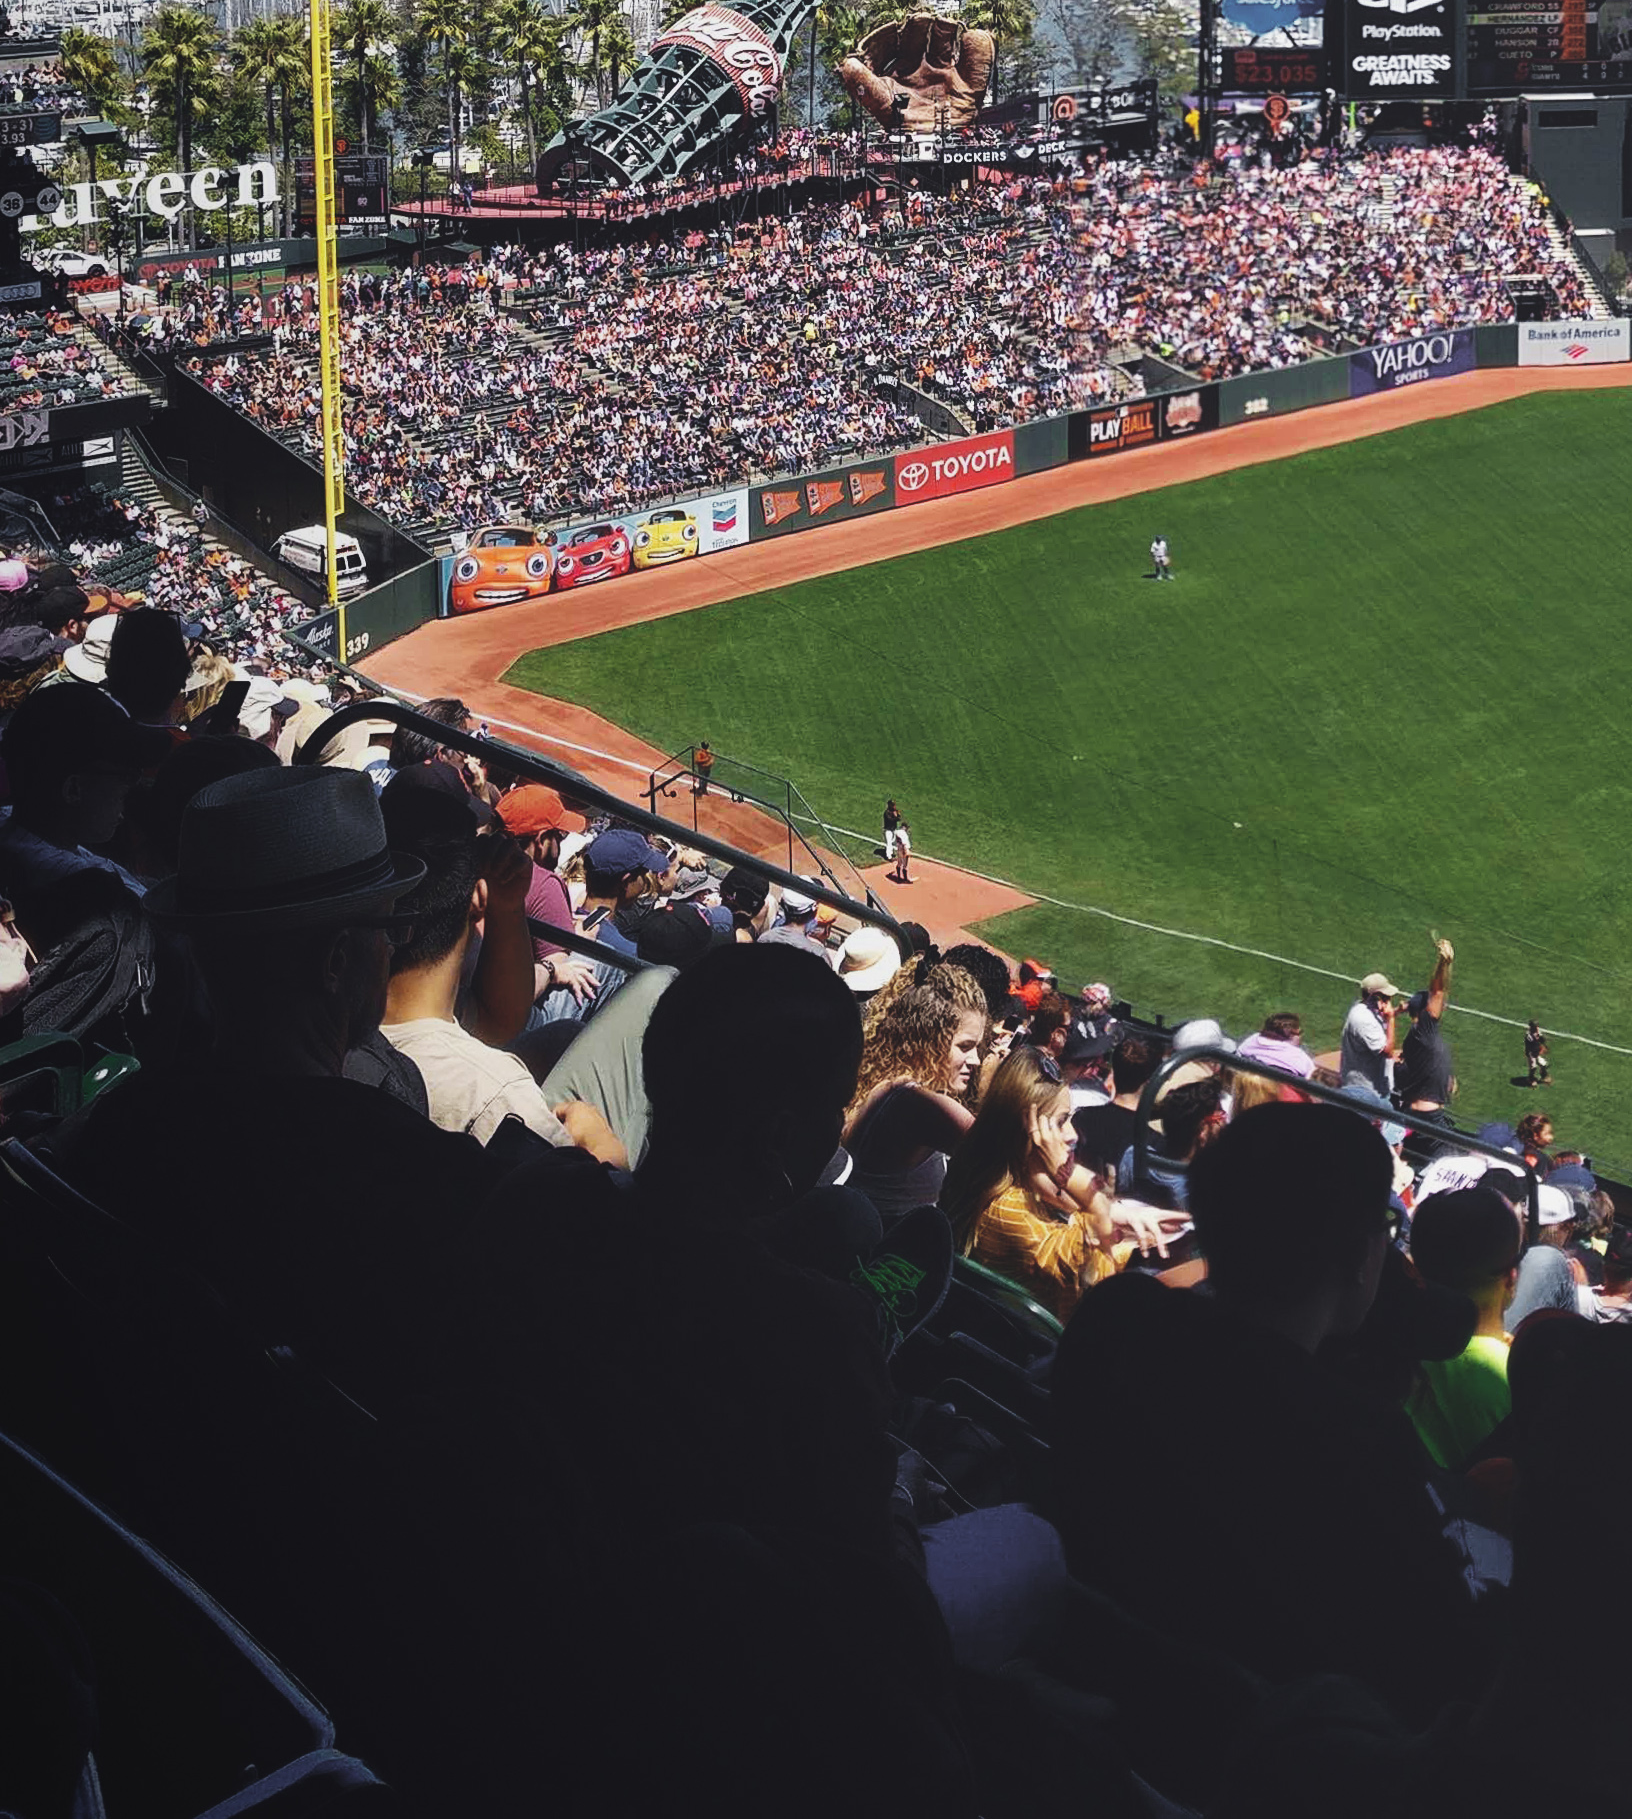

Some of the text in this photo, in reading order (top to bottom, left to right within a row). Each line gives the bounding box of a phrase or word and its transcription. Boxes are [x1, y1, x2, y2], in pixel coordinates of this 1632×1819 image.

[1362, 24, 1442, 41] PlayStation
[1352, 55, 1451, 71] GREATNESS
[944, 140, 1066, 164] DOCKERS DECK
[3, 193, 57, 212] 36 44
[18, 160, 281, 232] uveen
[1528, 327, 1621, 341] Bank of America
[1371, 334, 1454, 379] YAHOO!
[1394, 368, 1429, 386] SPORTS
[1090, 411, 1154, 443] PLAY BALL
[931, 445, 1012, 481] TOYOTA
[346, 633, 370, 658] 339
